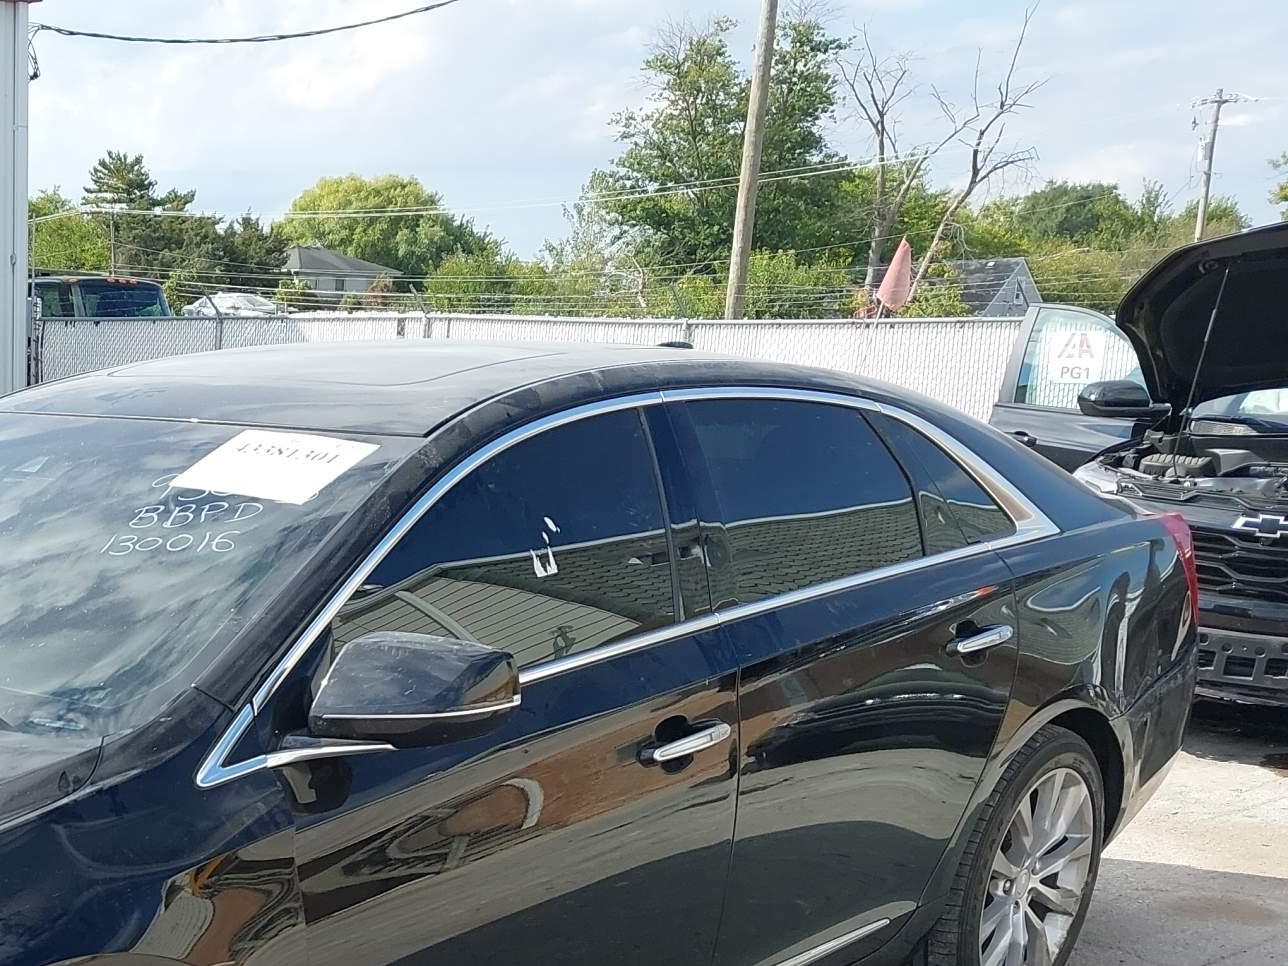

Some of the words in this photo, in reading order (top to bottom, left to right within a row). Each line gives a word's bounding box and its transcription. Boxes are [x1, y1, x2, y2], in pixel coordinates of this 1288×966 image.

[1060, 366, 1090, 380] PG1
[128, 502, 265, 530] BBPD
[100, 530, 241, 556] 130016
